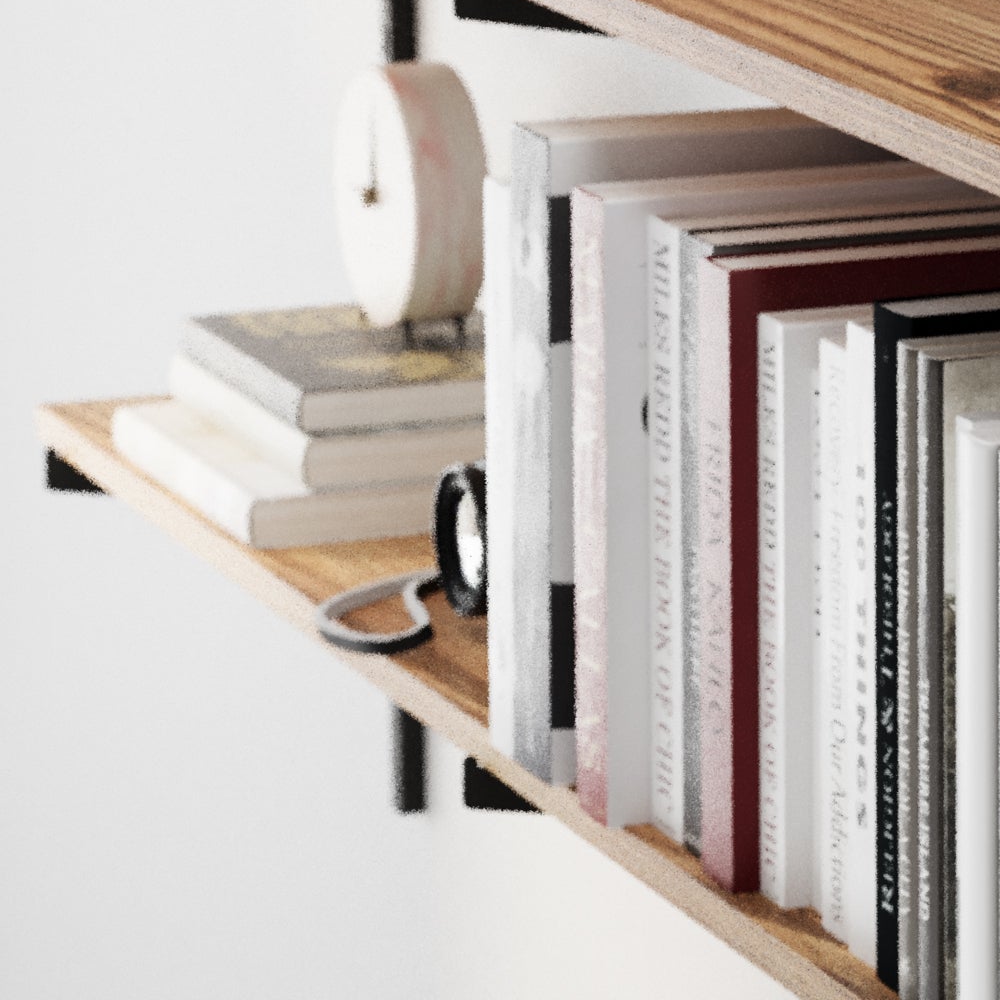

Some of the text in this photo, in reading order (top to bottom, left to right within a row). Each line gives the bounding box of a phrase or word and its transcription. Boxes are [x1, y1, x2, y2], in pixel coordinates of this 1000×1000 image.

[654, 476, 672, 547] THE
[654, 556, 672, 655] BOOK
[656, 665, 673, 717] OF
